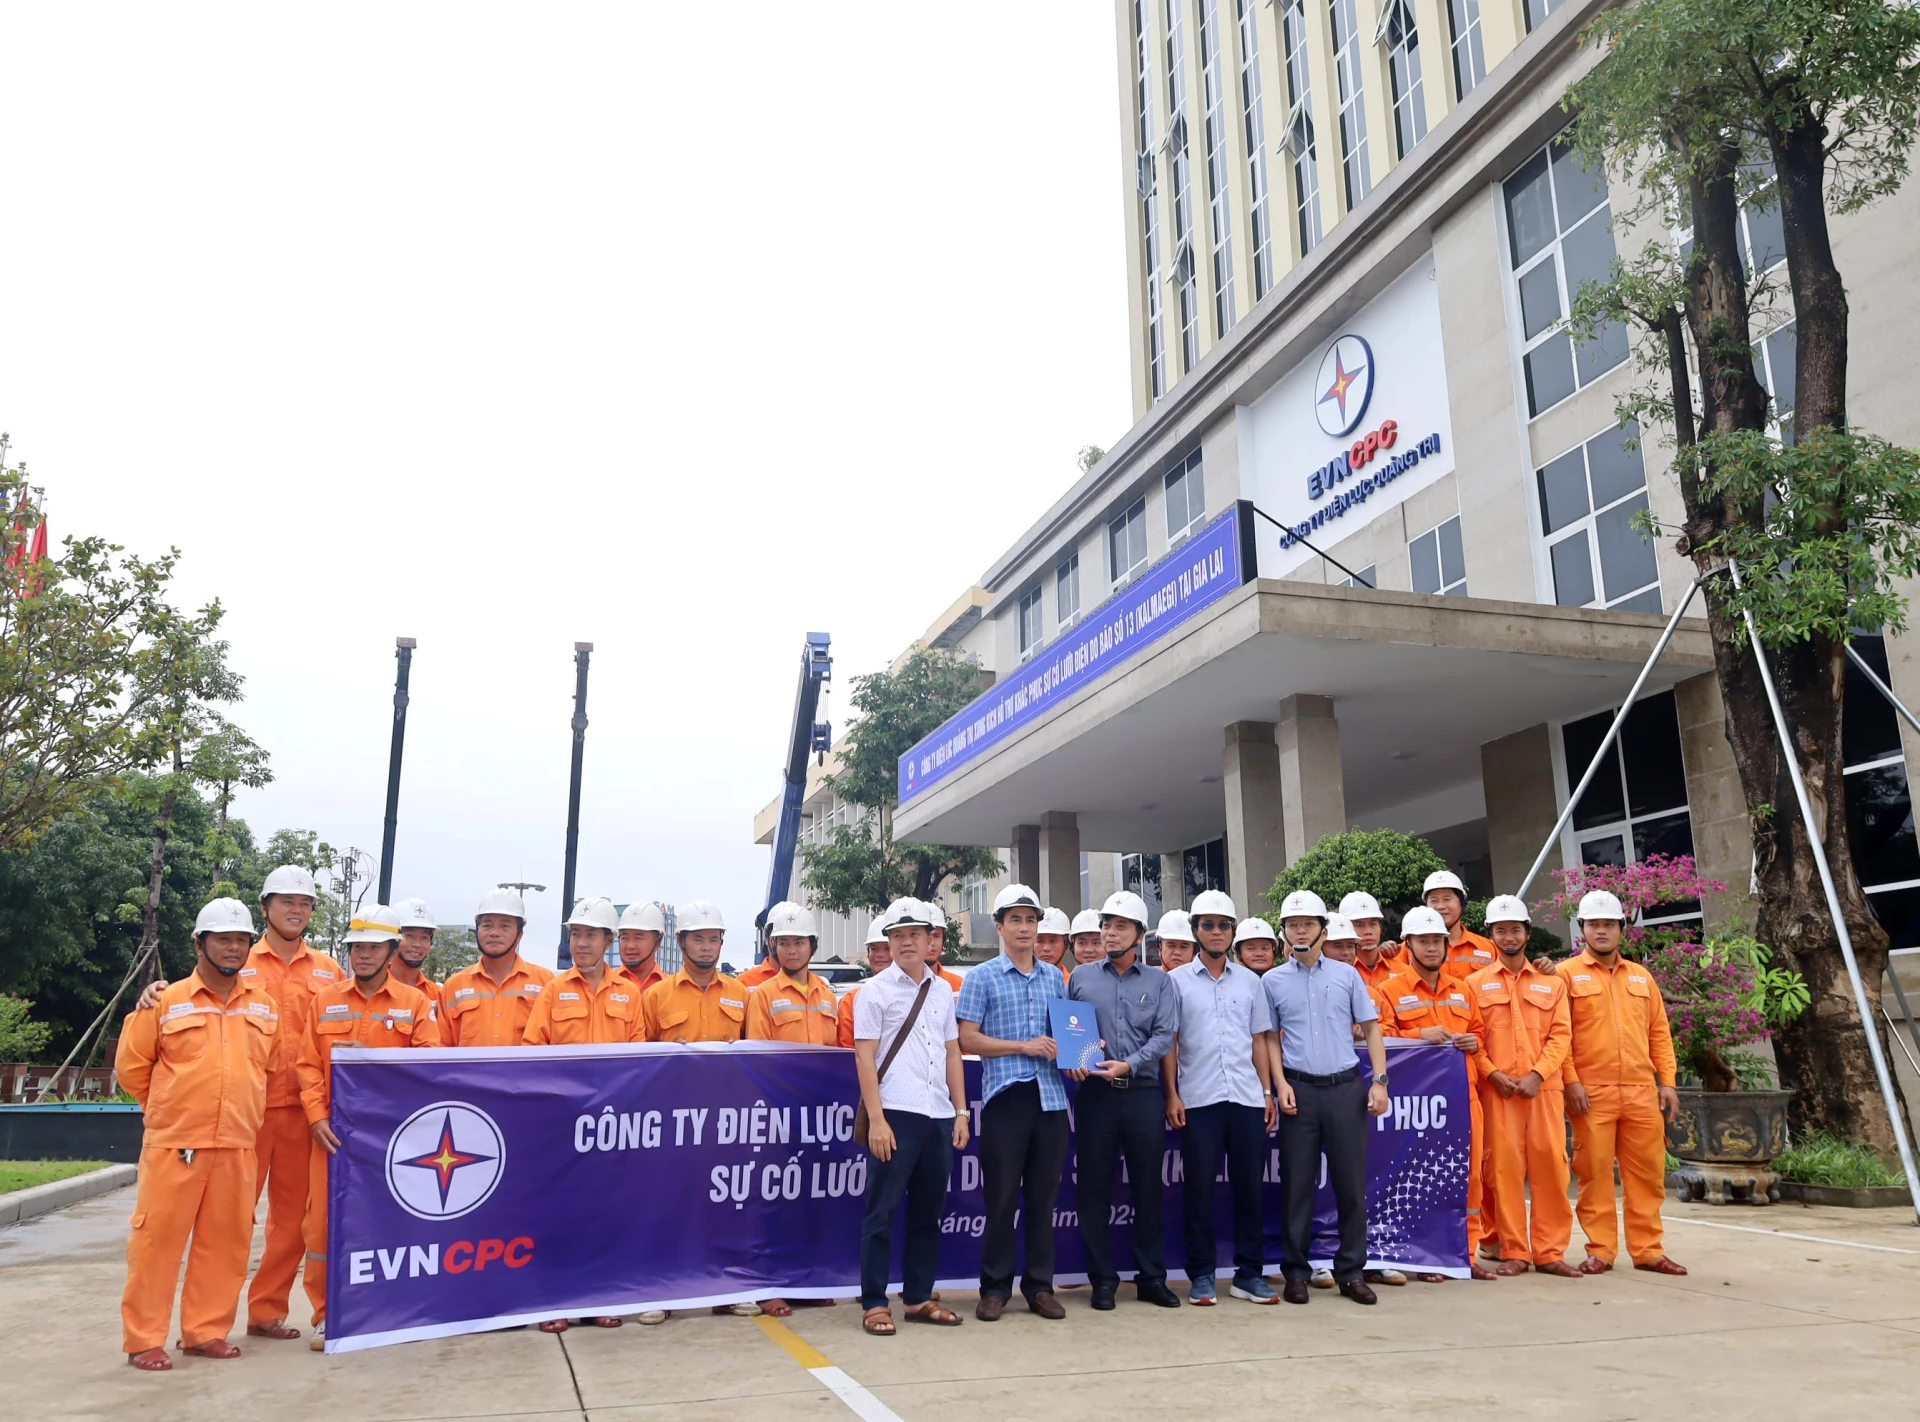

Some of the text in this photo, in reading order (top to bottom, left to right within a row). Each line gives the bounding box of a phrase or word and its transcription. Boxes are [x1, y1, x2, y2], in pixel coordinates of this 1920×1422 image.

[1307, 420, 1398, 500] EVNCPC
[1028, 676, 1042, 704] PHỤC
[1043, 667, 1051, 695] SỰ
[1051, 655, 1060, 688] CỐ
[1074, 642, 1089, 674] ĐIỆN
[1089, 636, 1098, 662] DO
[1099, 624, 1112, 655] BÃO
[1114, 608, 1124, 646] SỐ
[1125, 611, 1134, 638] 13
[1135, 580, 1178, 633] (KALMAEGI)
[1178, 569, 1192, 603] TẠI
[1193, 558, 1208, 591] GIA
[1209, 546, 1224, 580] LAI
[574, 1094, 1447, 1153] CÔNG TY ĐIỆN LỰC PHỤC
[709, 1160, 756, 1210] SỰ
[761, 1150, 804, 1201] CỐ
[811, 1153, 867, 1198] LƯỚ
[349, 1235, 535, 1285] EVNCPC
